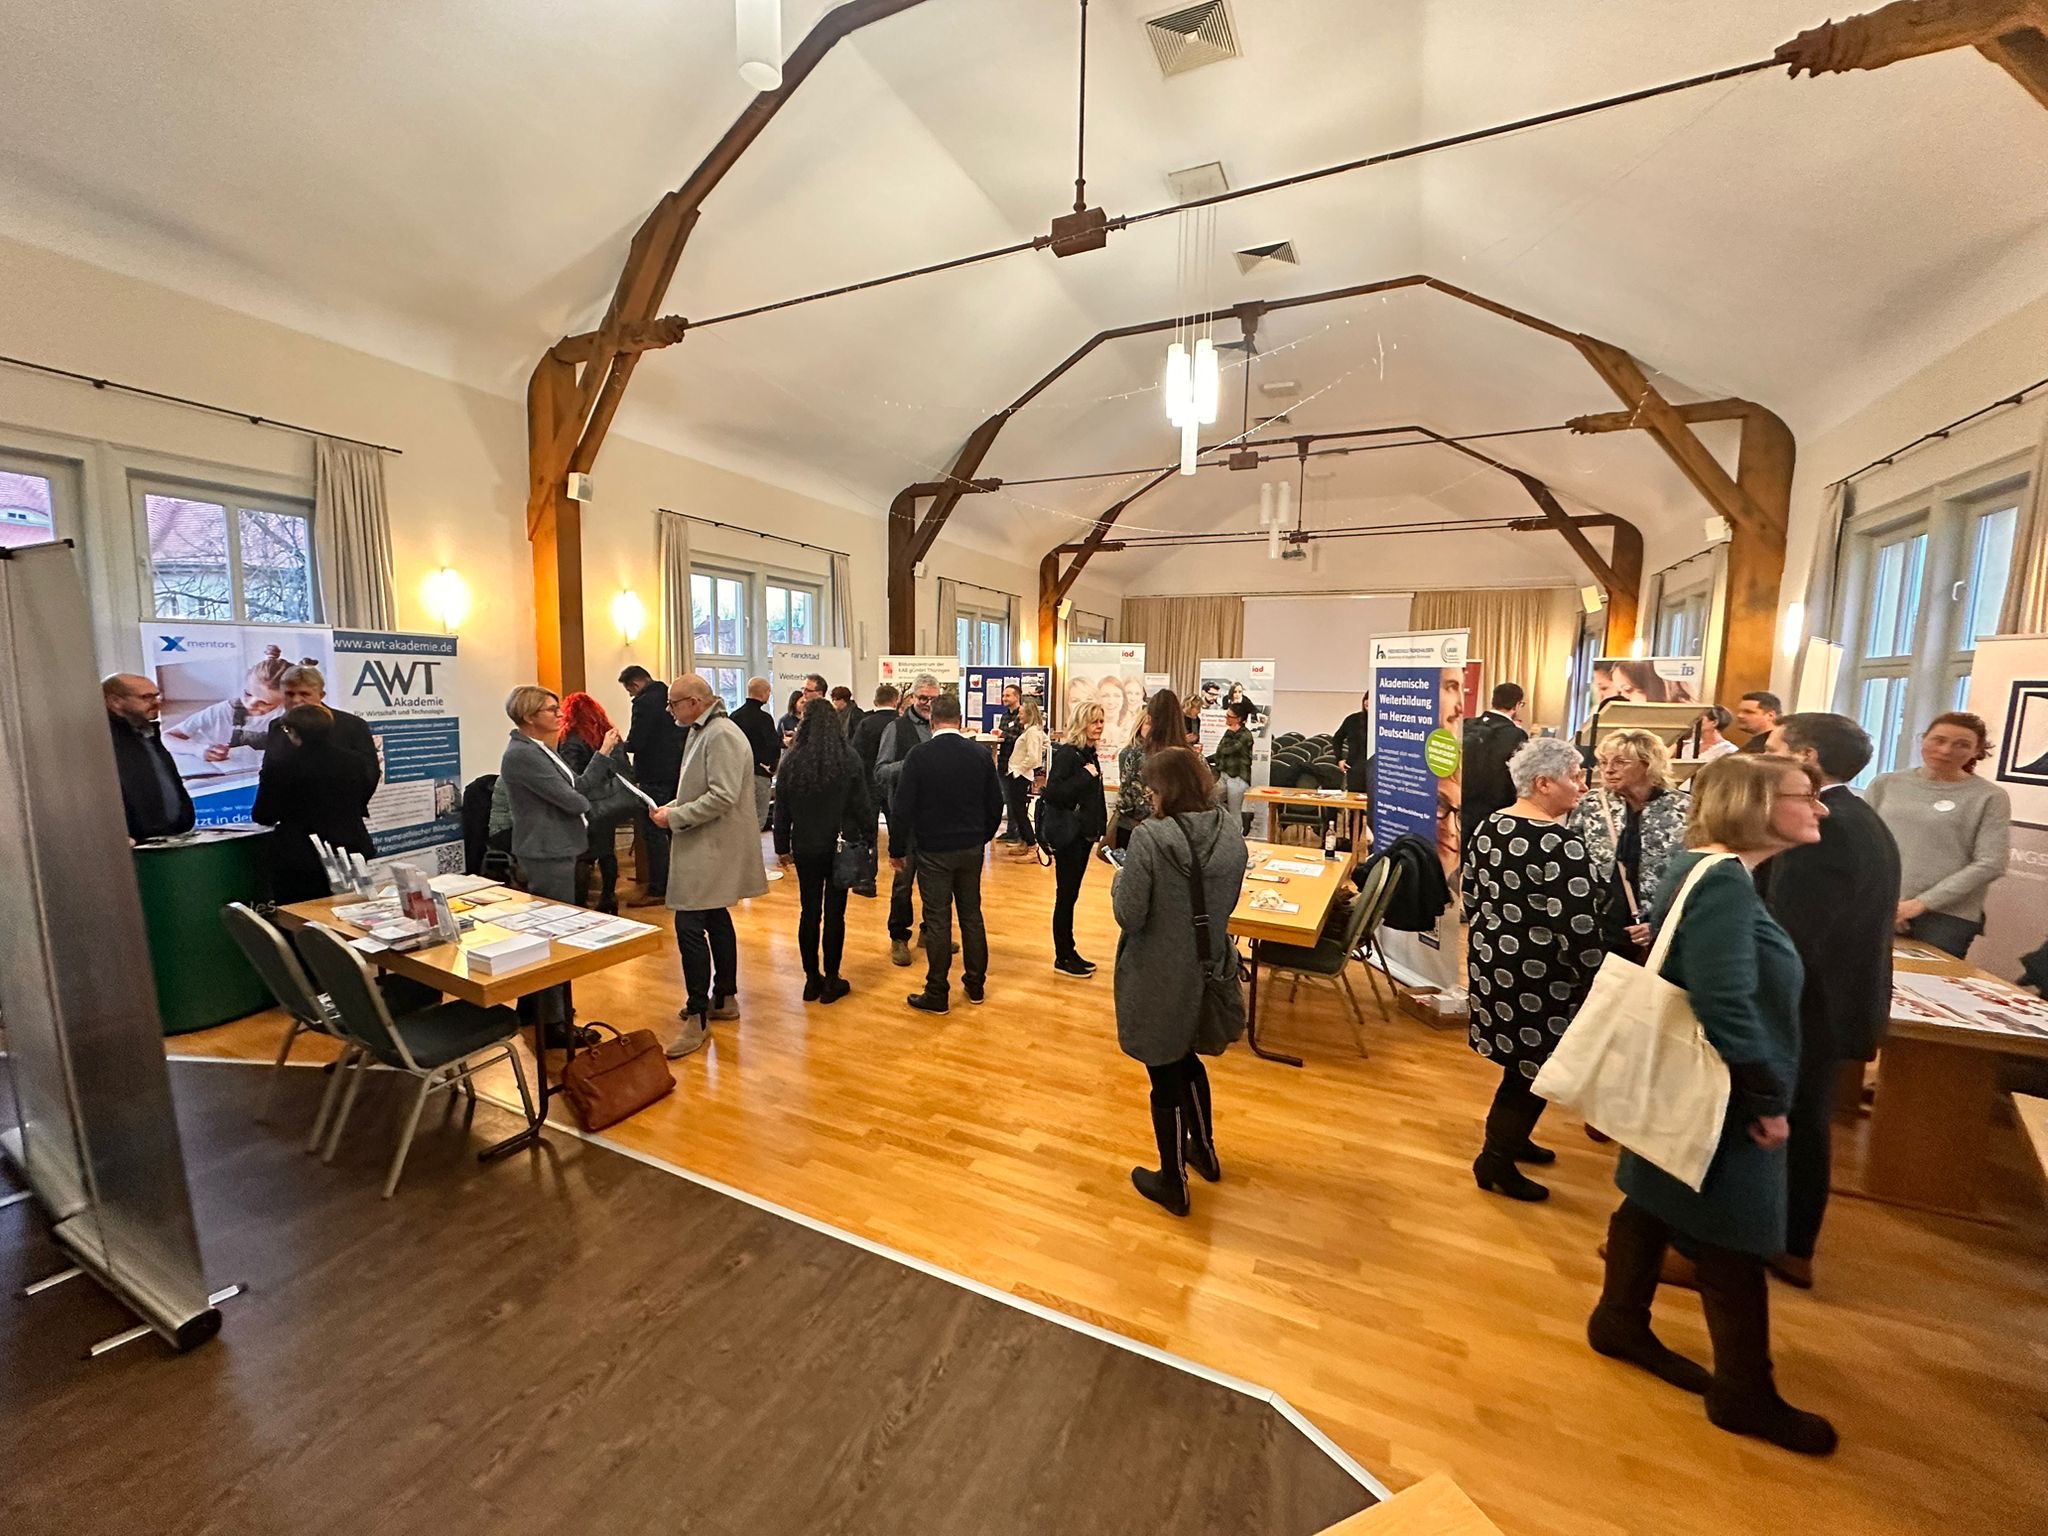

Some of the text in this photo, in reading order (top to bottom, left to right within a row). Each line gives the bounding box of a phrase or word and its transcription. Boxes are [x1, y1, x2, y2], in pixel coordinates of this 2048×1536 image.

[187, 639, 237, 649] mentors
[333, 639, 454, 653] www.awt-akademie.de
[791, 652, 820, 661] randstad
[779, 672, 807, 681] Weiterbi
[352, 660, 441, 707] AWT
[1379, 677, 1430, 690] Akademische
[394, 696, 444, 708] Akademie
[1378, 693, 1433, 710] Weiterbildung
[366, 709, 398, 717] Wirtschaft
[1379, 709, 1433, 726] im Herzen von
[1378, 726, 1425, 742] Deutschland
[195, 817, 213, 826] tzt
[216, 815, 228, 824] in
